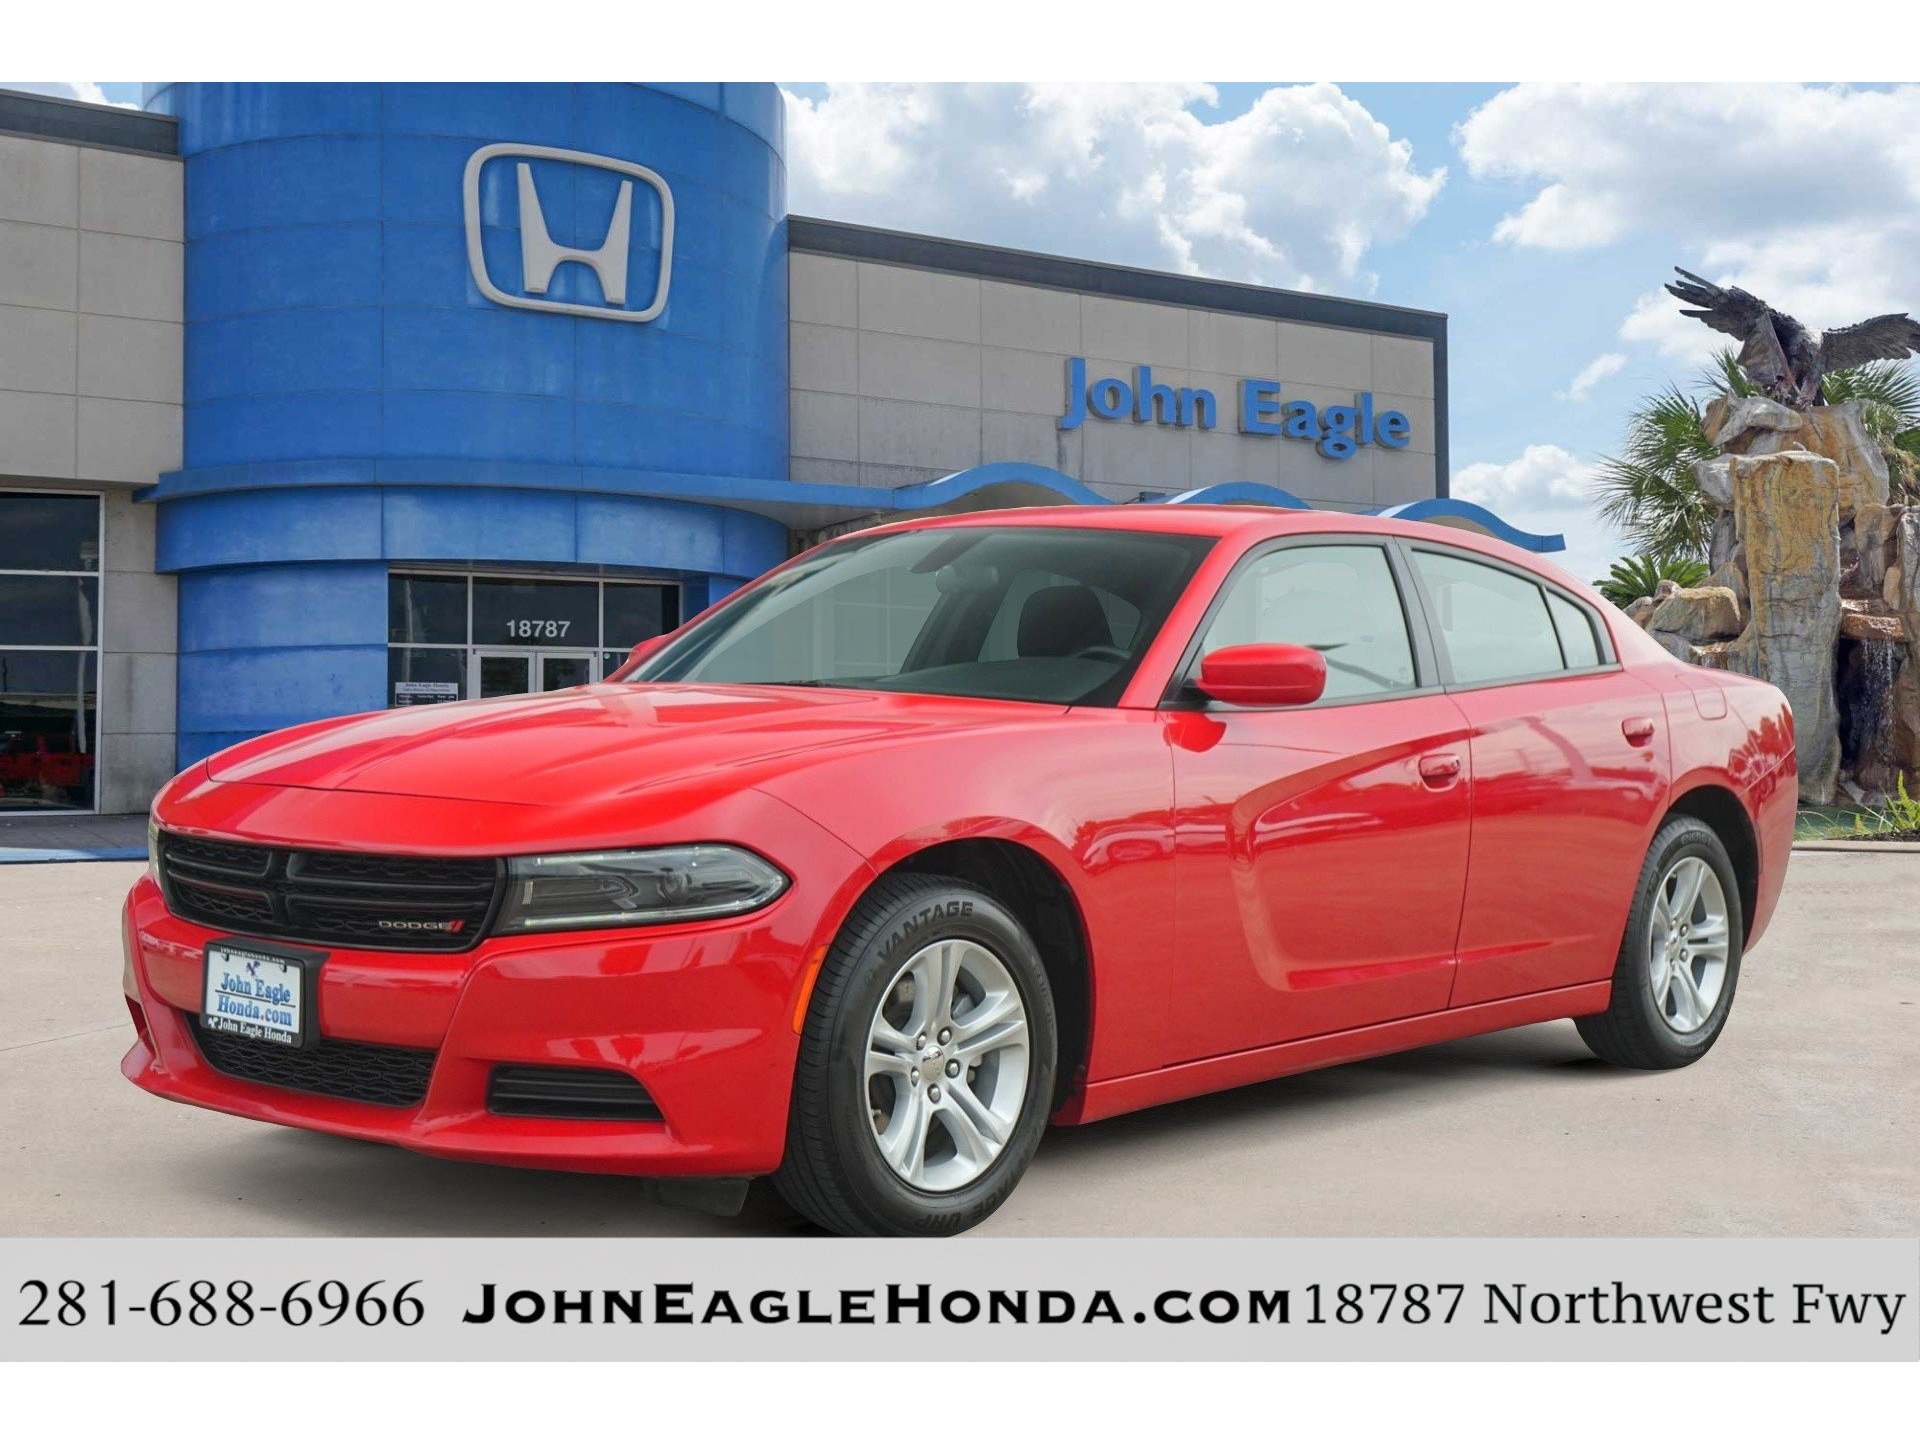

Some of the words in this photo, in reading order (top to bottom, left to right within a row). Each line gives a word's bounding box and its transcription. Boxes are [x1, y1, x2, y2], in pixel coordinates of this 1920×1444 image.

[1057, 355, 1217, 431] John
[1237, 377, 1412, 460] Eagle
[506, 619, 571, 637] 18787
[379, 920, 452, 930] DODGE
[877, 900, 974, 960] VANTAGE
[221, 972, 252, 995] John
[255, 979, 291, 1005] Eagle
[217, 994, 292, 1026] Honda.com
[218, 1017, 238, 1033] John
[240, 1022, 262, 1038] Eagle
[264, 1027, 292, 1044] Honda
